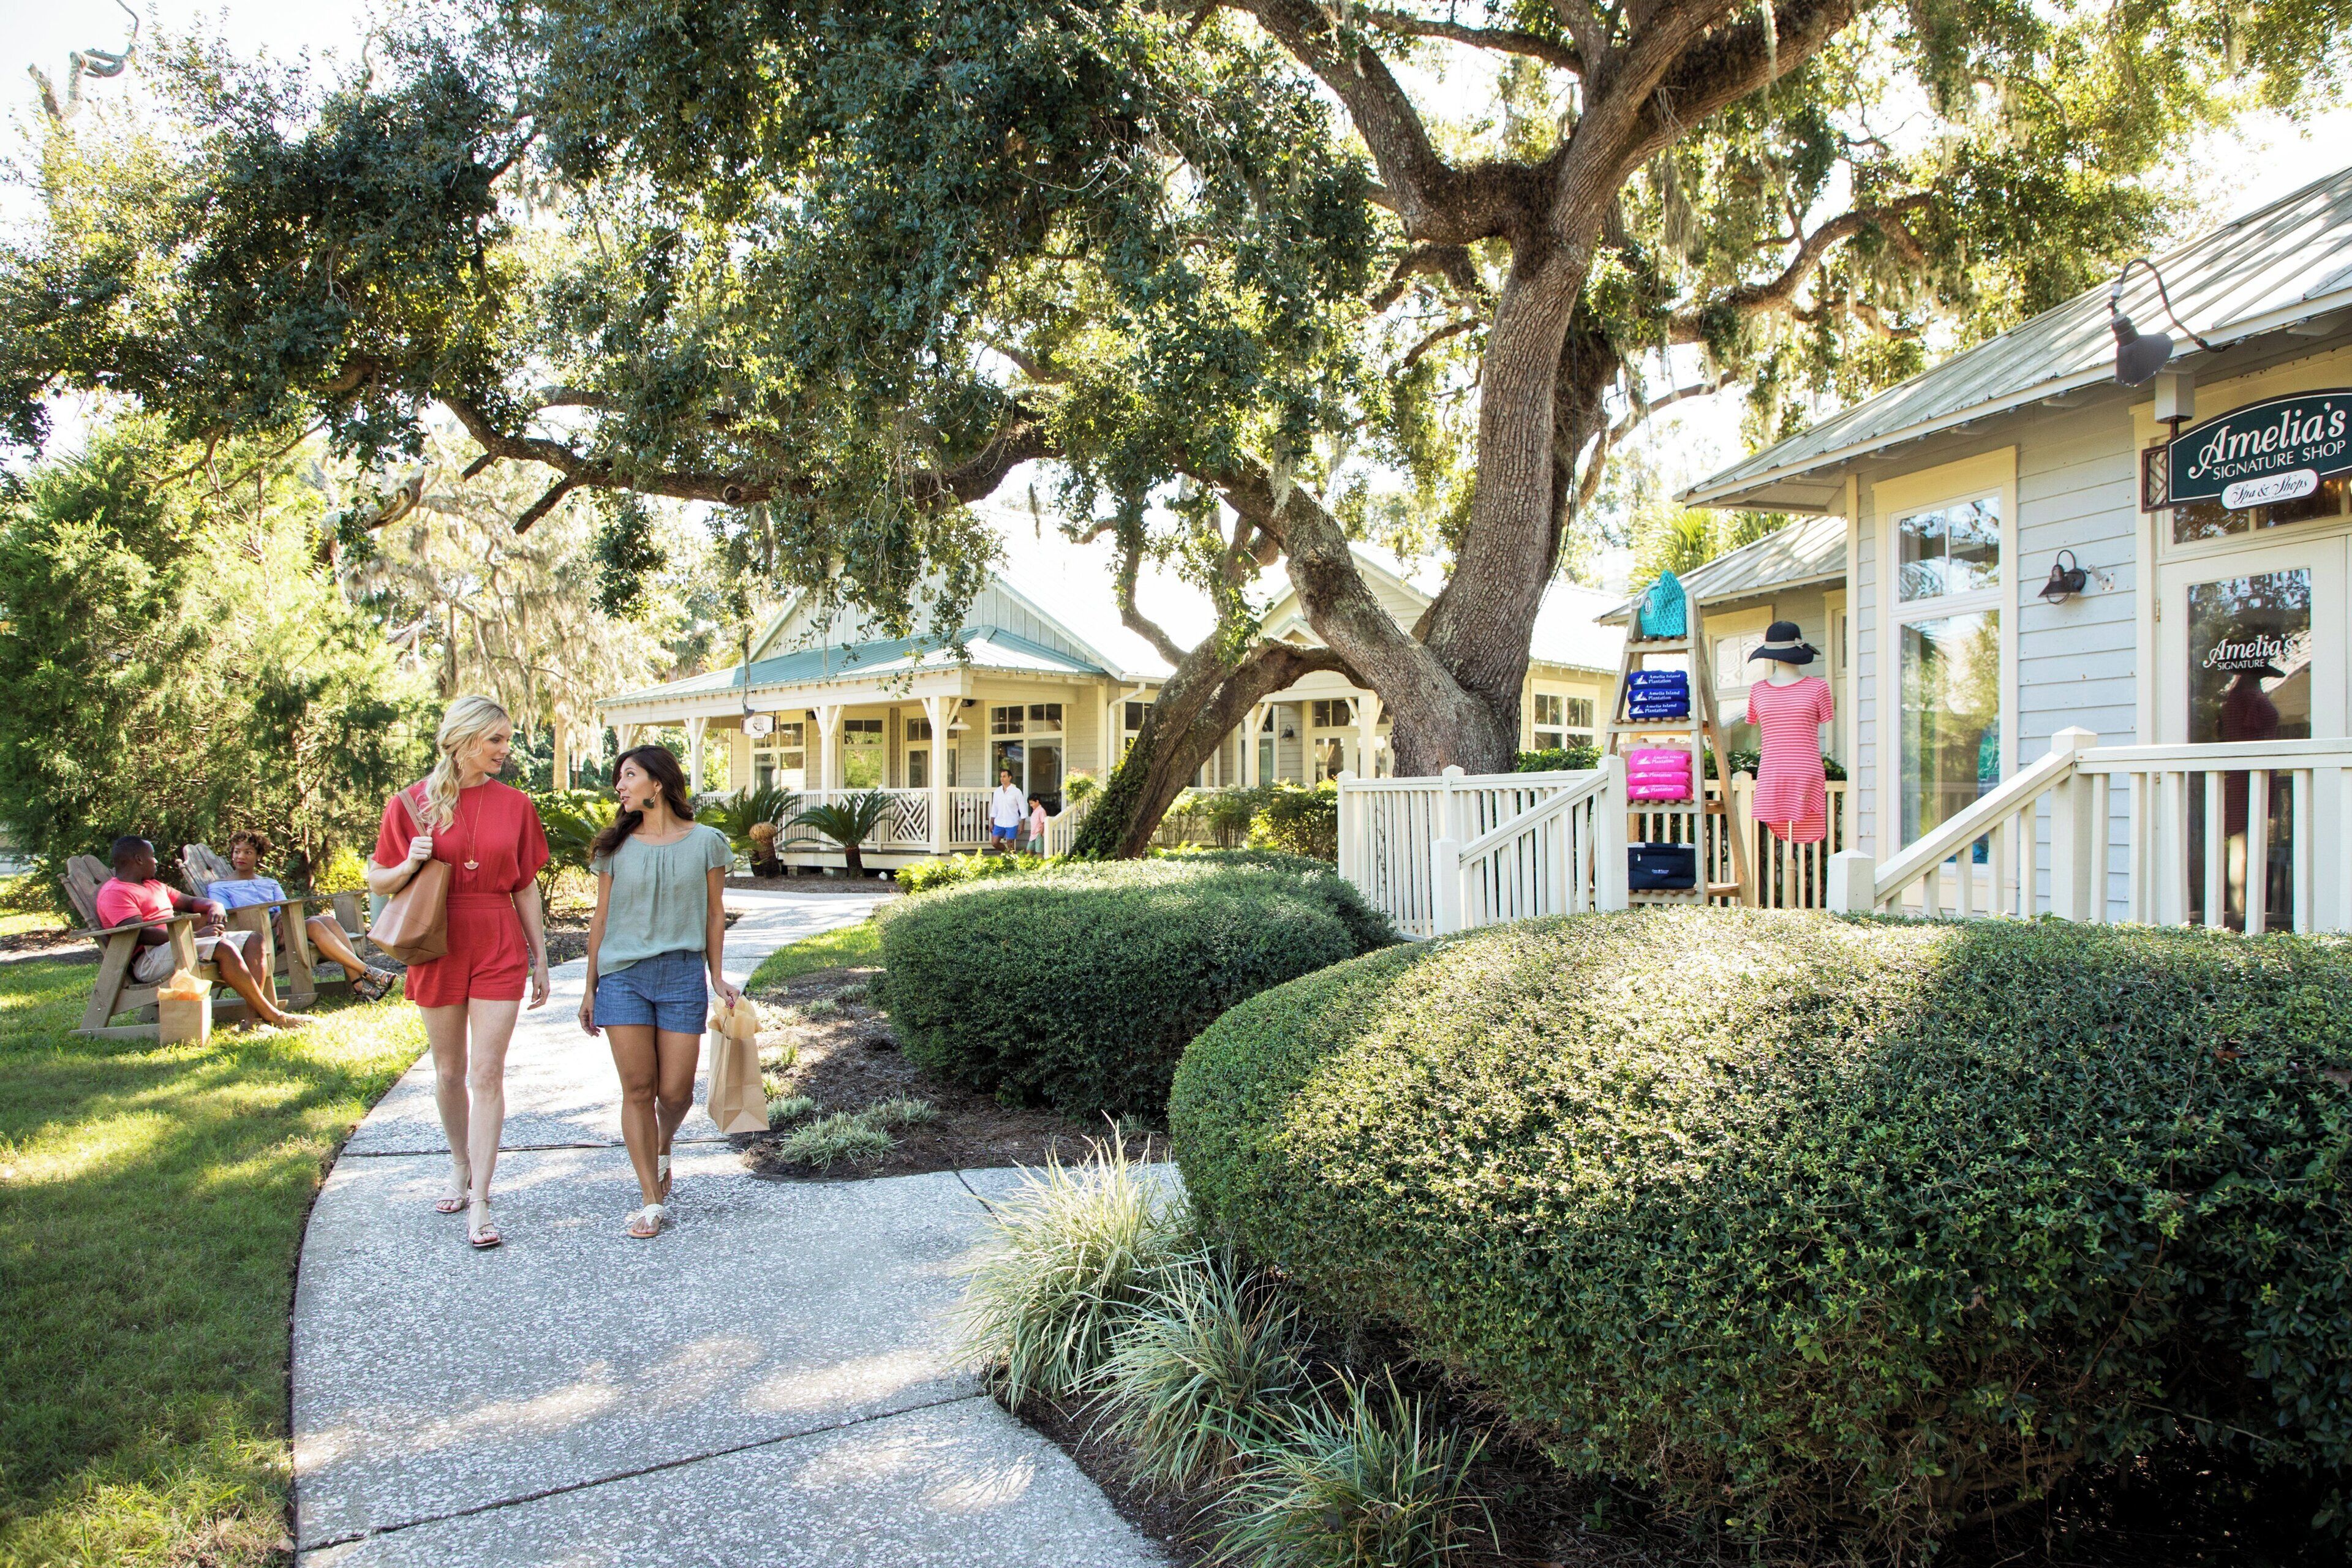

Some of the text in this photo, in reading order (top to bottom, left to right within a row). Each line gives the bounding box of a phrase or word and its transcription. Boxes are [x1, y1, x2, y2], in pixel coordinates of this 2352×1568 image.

[2188, 402, 2346, 480] Amelia's
[2212, 440, 2346, 480] SIGNATURE SHOP
[2231, 474, 2308, 505] Spa & Shops
[2203, 633, 2294, 668] Amelia's
[2217, 658, 2265, 671] SIGNATURE
